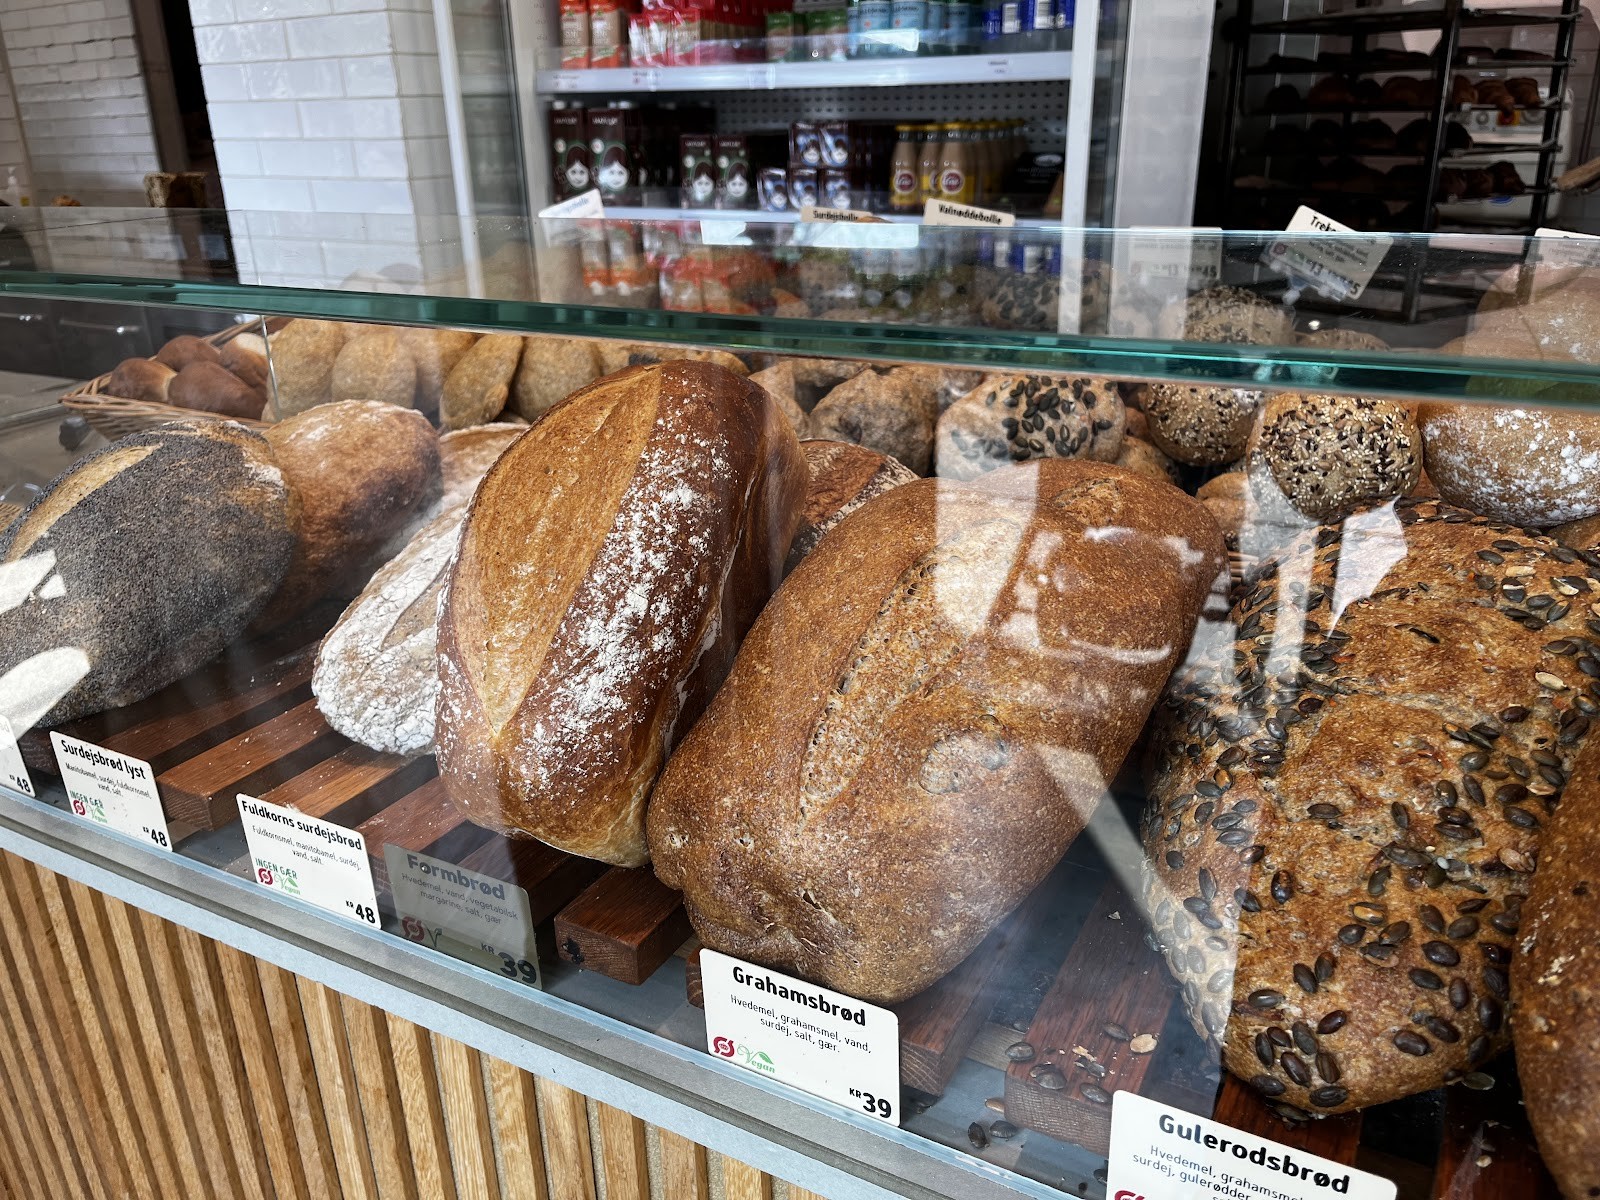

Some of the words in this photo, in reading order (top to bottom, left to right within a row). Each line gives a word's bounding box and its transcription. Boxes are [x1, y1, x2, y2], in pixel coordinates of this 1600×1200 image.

[61, 739, 124, 772] Surdejsbrød
[123, 759, 146, 780] lyst
[16, 776, 31, 793] 48
[69, 790, 89, 803] INGEN
[151, 828, 168, 847] 48
[241, 800, 295, 828] Fuldkorns
[297, 820, 363, 850] surdejsbrød
[255, 857, 278, 872] INGEN
[280, 866, 298, 880] GÆR
[406, 853, 506, 901] Formbrød
[345, 900, 354, 908] KR
[355, 903, 376, 924] 48
[401, 872, 444, 894] Hvedemel,
[446, 887, 468, 903] vand,
[470, 895, 519, 921] vegetabilsk
[465, 906, 483, 919] salt,
[481, 942, 495, 955] KR
[498, 951, 537, 985] 39
[733, 966, 866, 1027] Grahamsbrød
[730, 994, 779, 1020] Hvedemel,
[780, 1012, 842, 1043] grahamsmel,
[844, 1035, 872, 1054] vand,
[760, 1017, 793, 1037] surdej,
[794, 1028, 815, 1045] salt,
[818, 1038, 840, 1053] gær.
[737, 1043, 776, 1074] Vegan
[849, 1087, 862, 1099] KR
[862, 1092, 892, 1119] 39
[1132, 1152, 1176, 1178] surdej,
[1150, 1144, 1217, 1178] Hvedemel,
[1158, 1113, 1351, 1195] Gulerodsbrød
